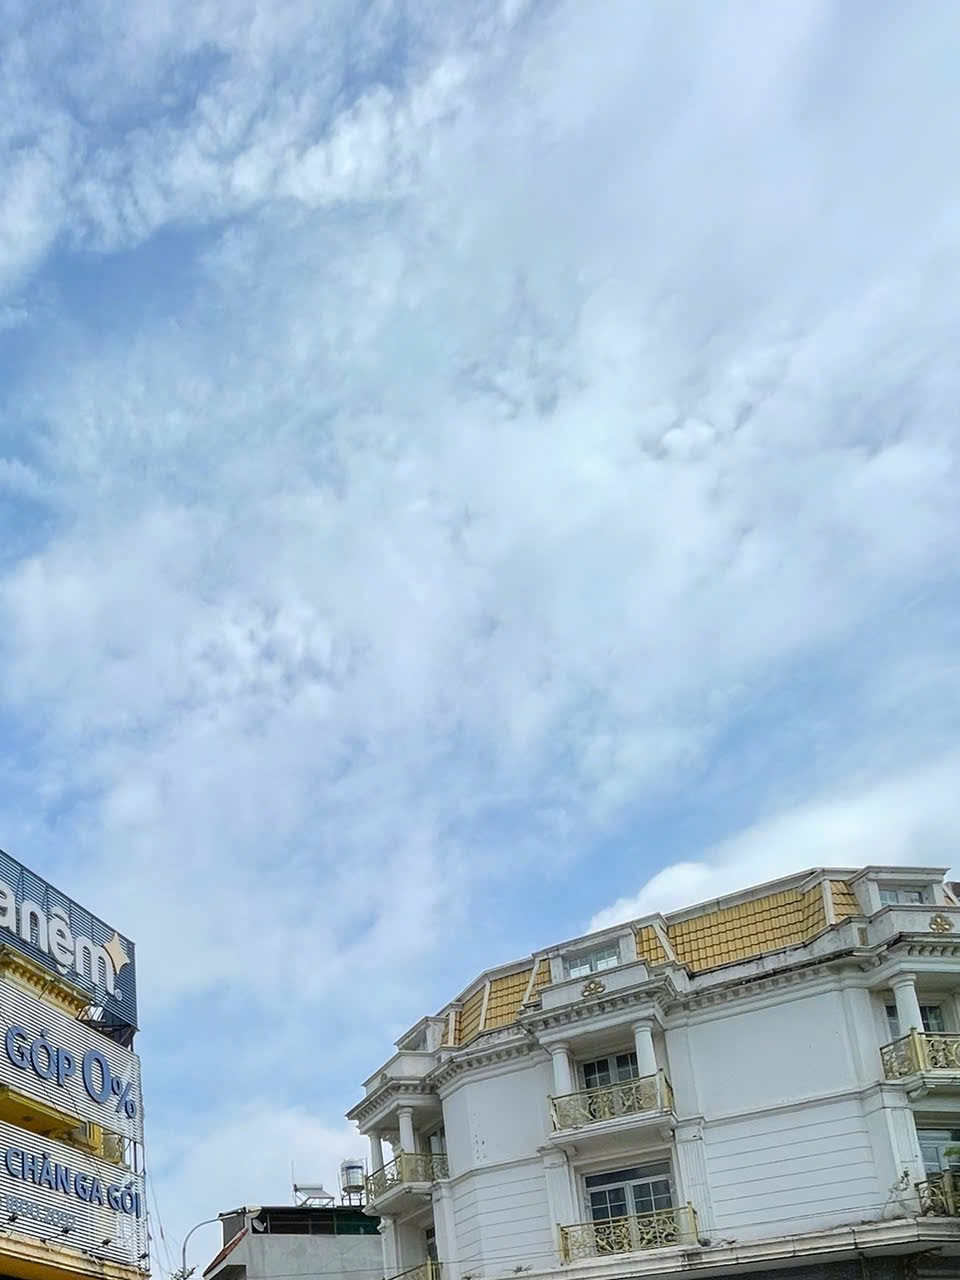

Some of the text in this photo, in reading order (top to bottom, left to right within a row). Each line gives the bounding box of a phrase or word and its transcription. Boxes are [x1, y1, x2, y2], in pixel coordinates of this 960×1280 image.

[5, 1024, 77, 1087] GÓP
[82, 1049, 137, 1119] 0%
[4, 1147, 71, 1195] CHĂN
[74, 1172, 105, 1207] GA
[106, 1180, 140, 1219] GỐI
